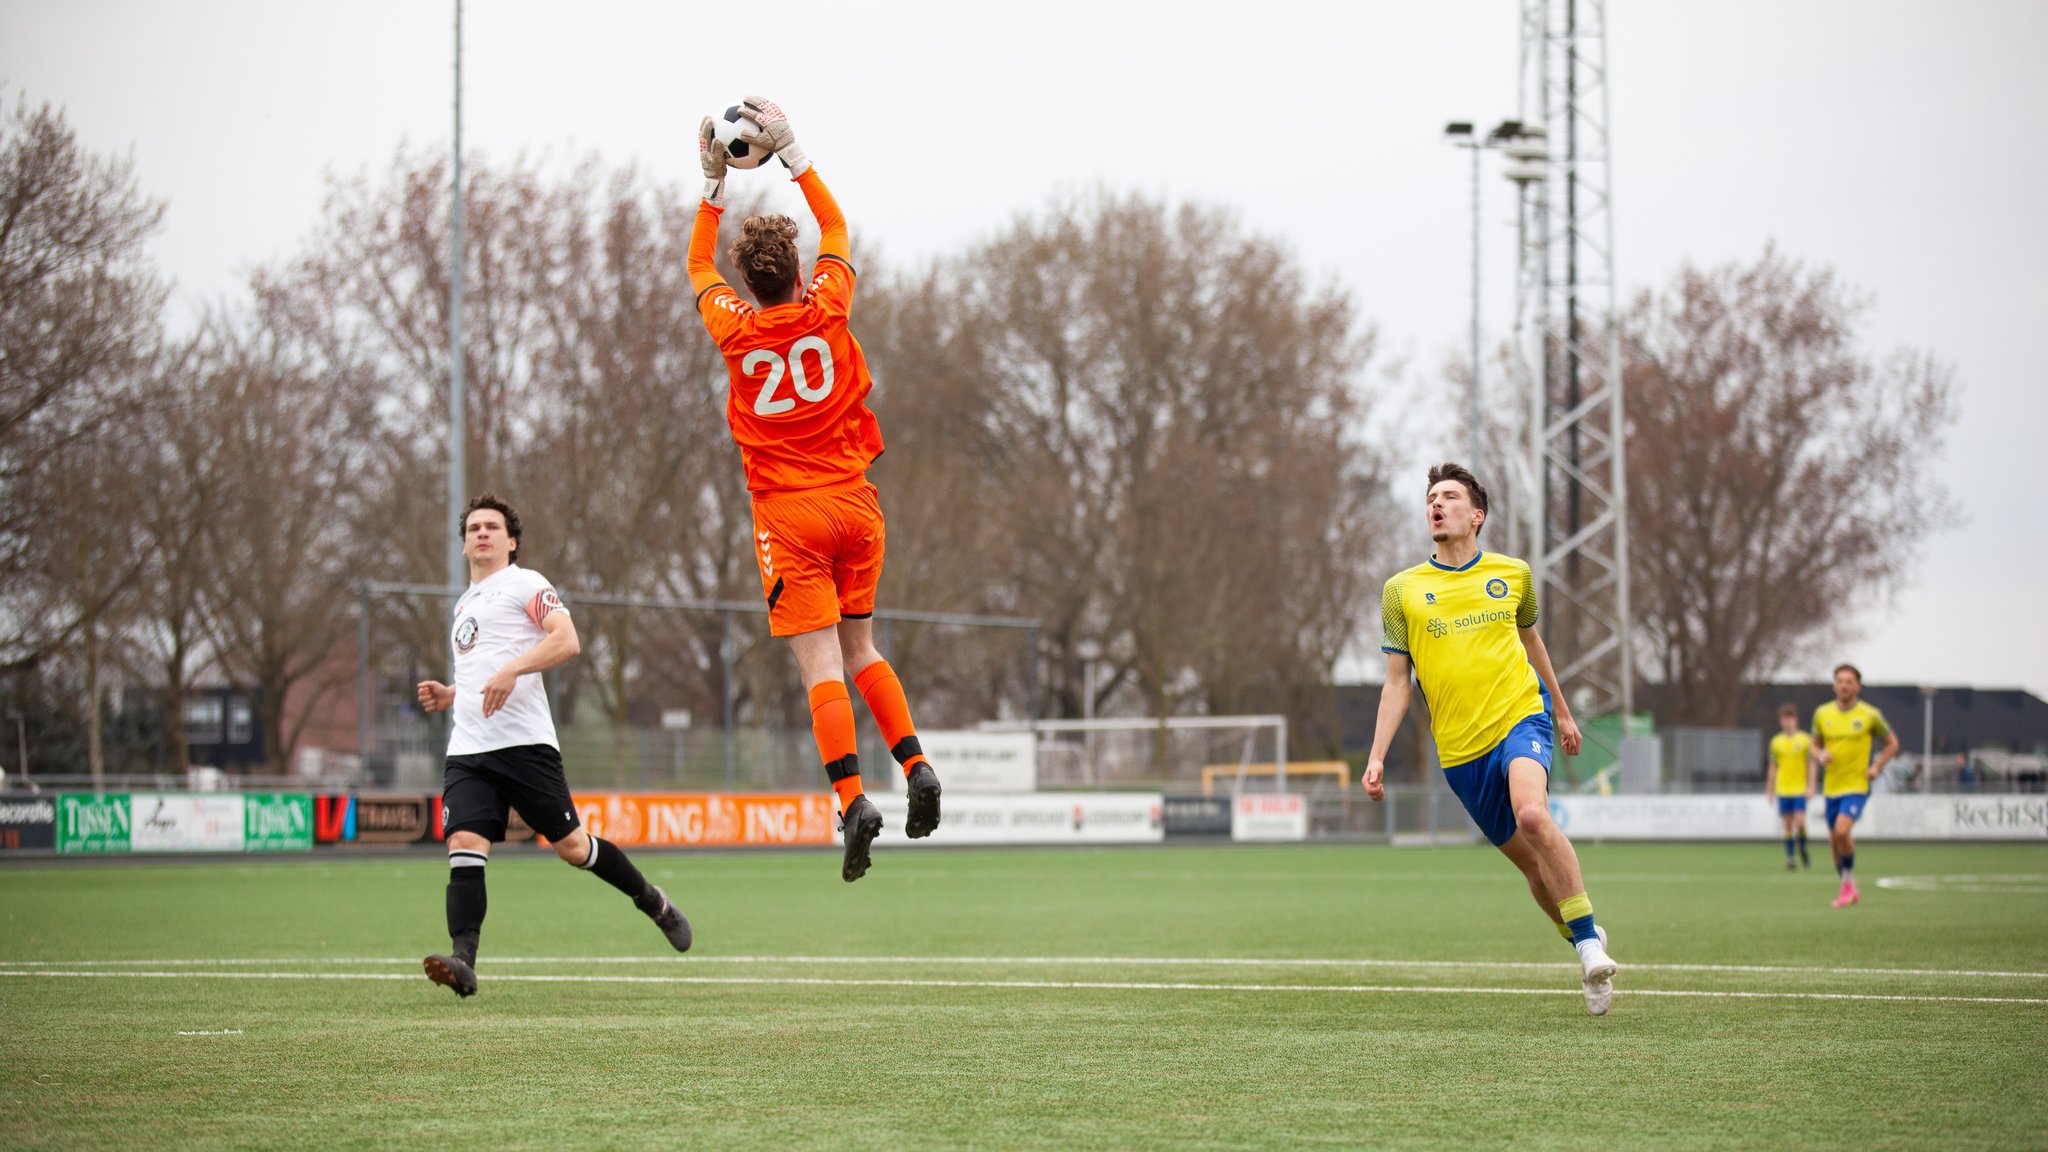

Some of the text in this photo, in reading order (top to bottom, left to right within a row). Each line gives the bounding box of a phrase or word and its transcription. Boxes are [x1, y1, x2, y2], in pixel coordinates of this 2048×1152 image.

[742, 335, 834, 416] 20
[1455, 610, 1511, 628] solutions
[649, 803, 703, 843] ING
[745, 804, 798, 843] ING
